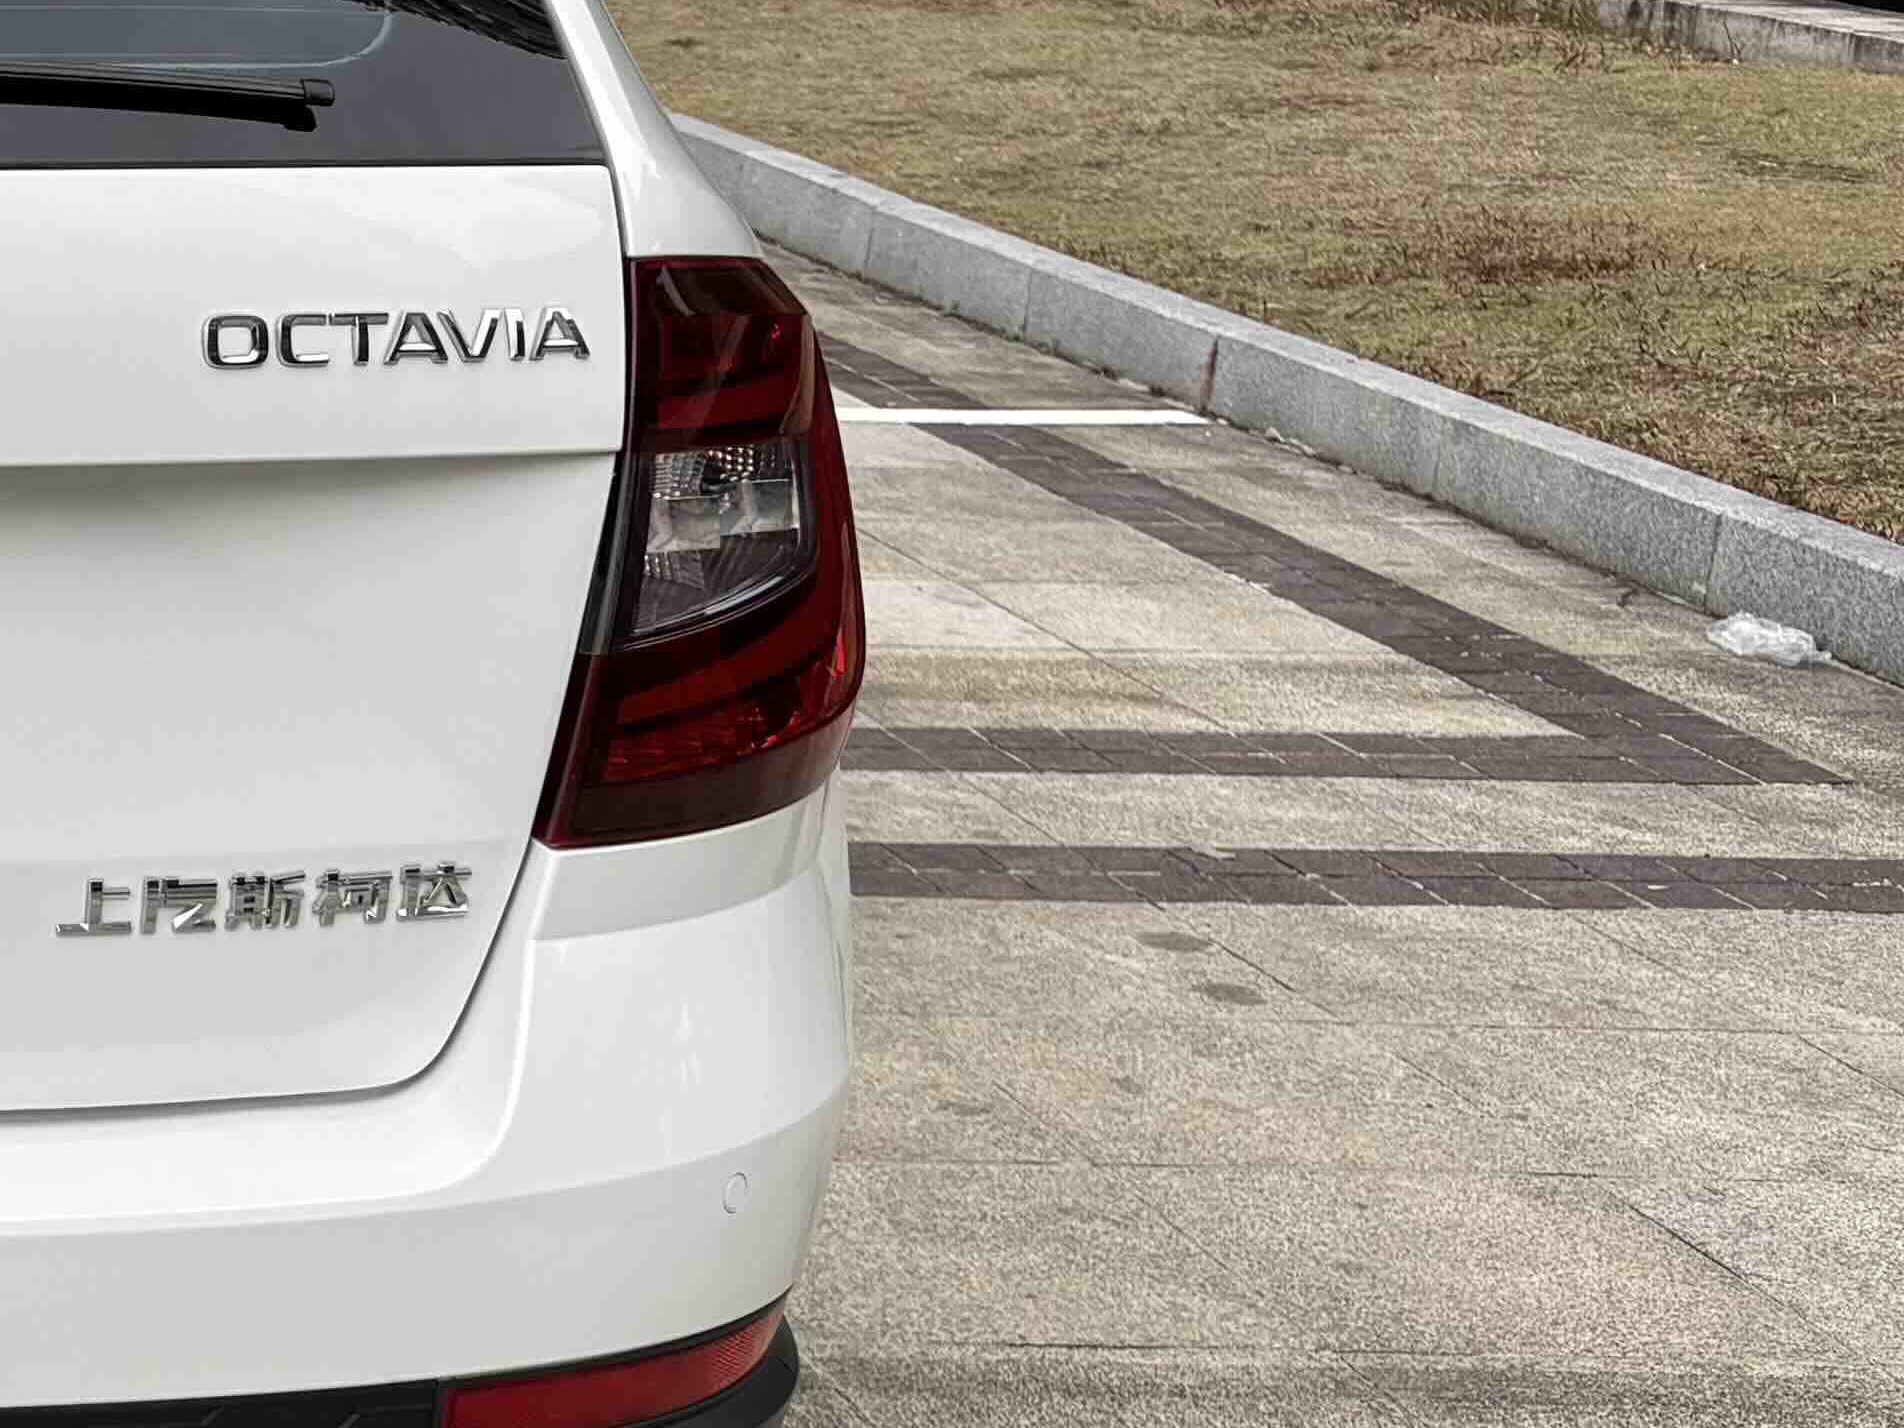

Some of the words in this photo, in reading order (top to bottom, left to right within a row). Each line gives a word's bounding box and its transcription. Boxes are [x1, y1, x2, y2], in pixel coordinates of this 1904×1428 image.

[201, 307, 591, 370] OCTAVIA
[55, 861, 473, 935] 上汽斯柯达
